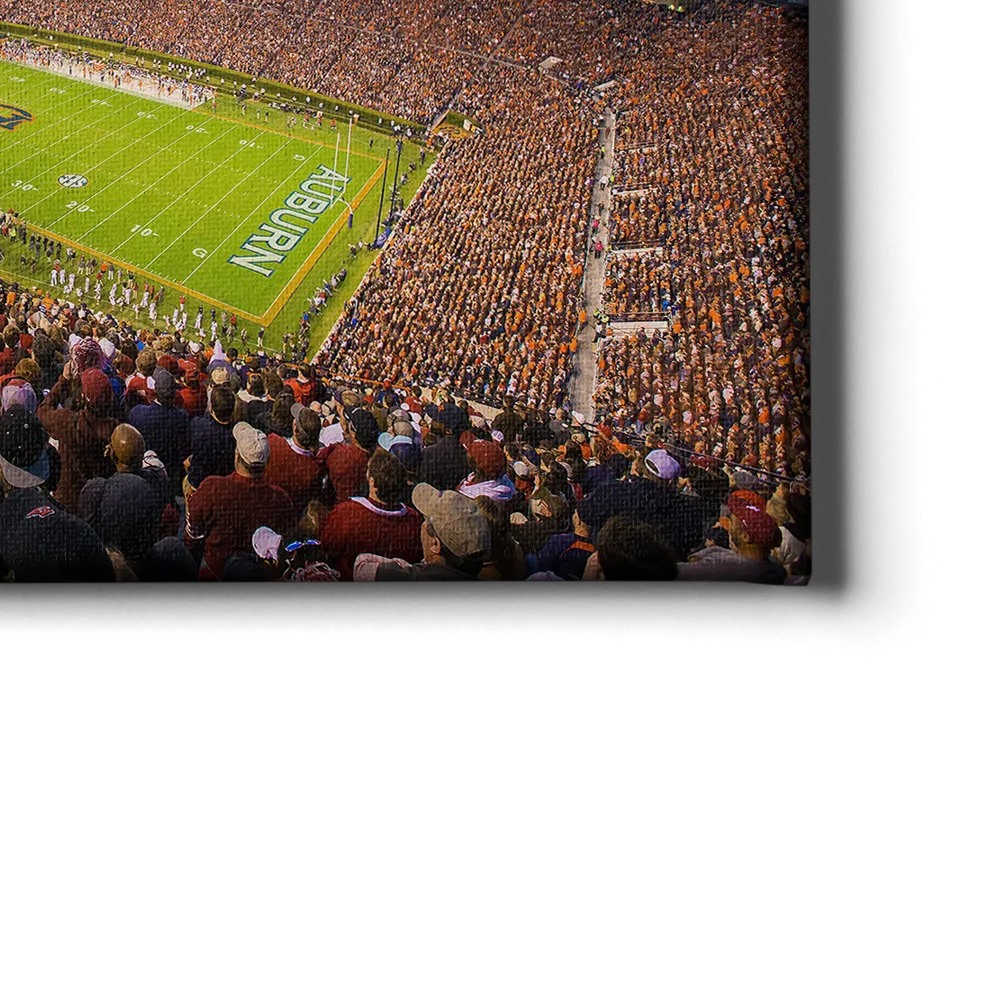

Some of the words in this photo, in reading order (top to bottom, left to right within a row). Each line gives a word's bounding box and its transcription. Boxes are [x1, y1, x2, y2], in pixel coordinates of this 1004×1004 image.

[11, 179, 34, 191] 30
[65, 200, 90, 213] 20
[227, 164, 352, 278] AUBURN
[130, 224, 153, 237] 10
[192, 247, 208, 259] G
